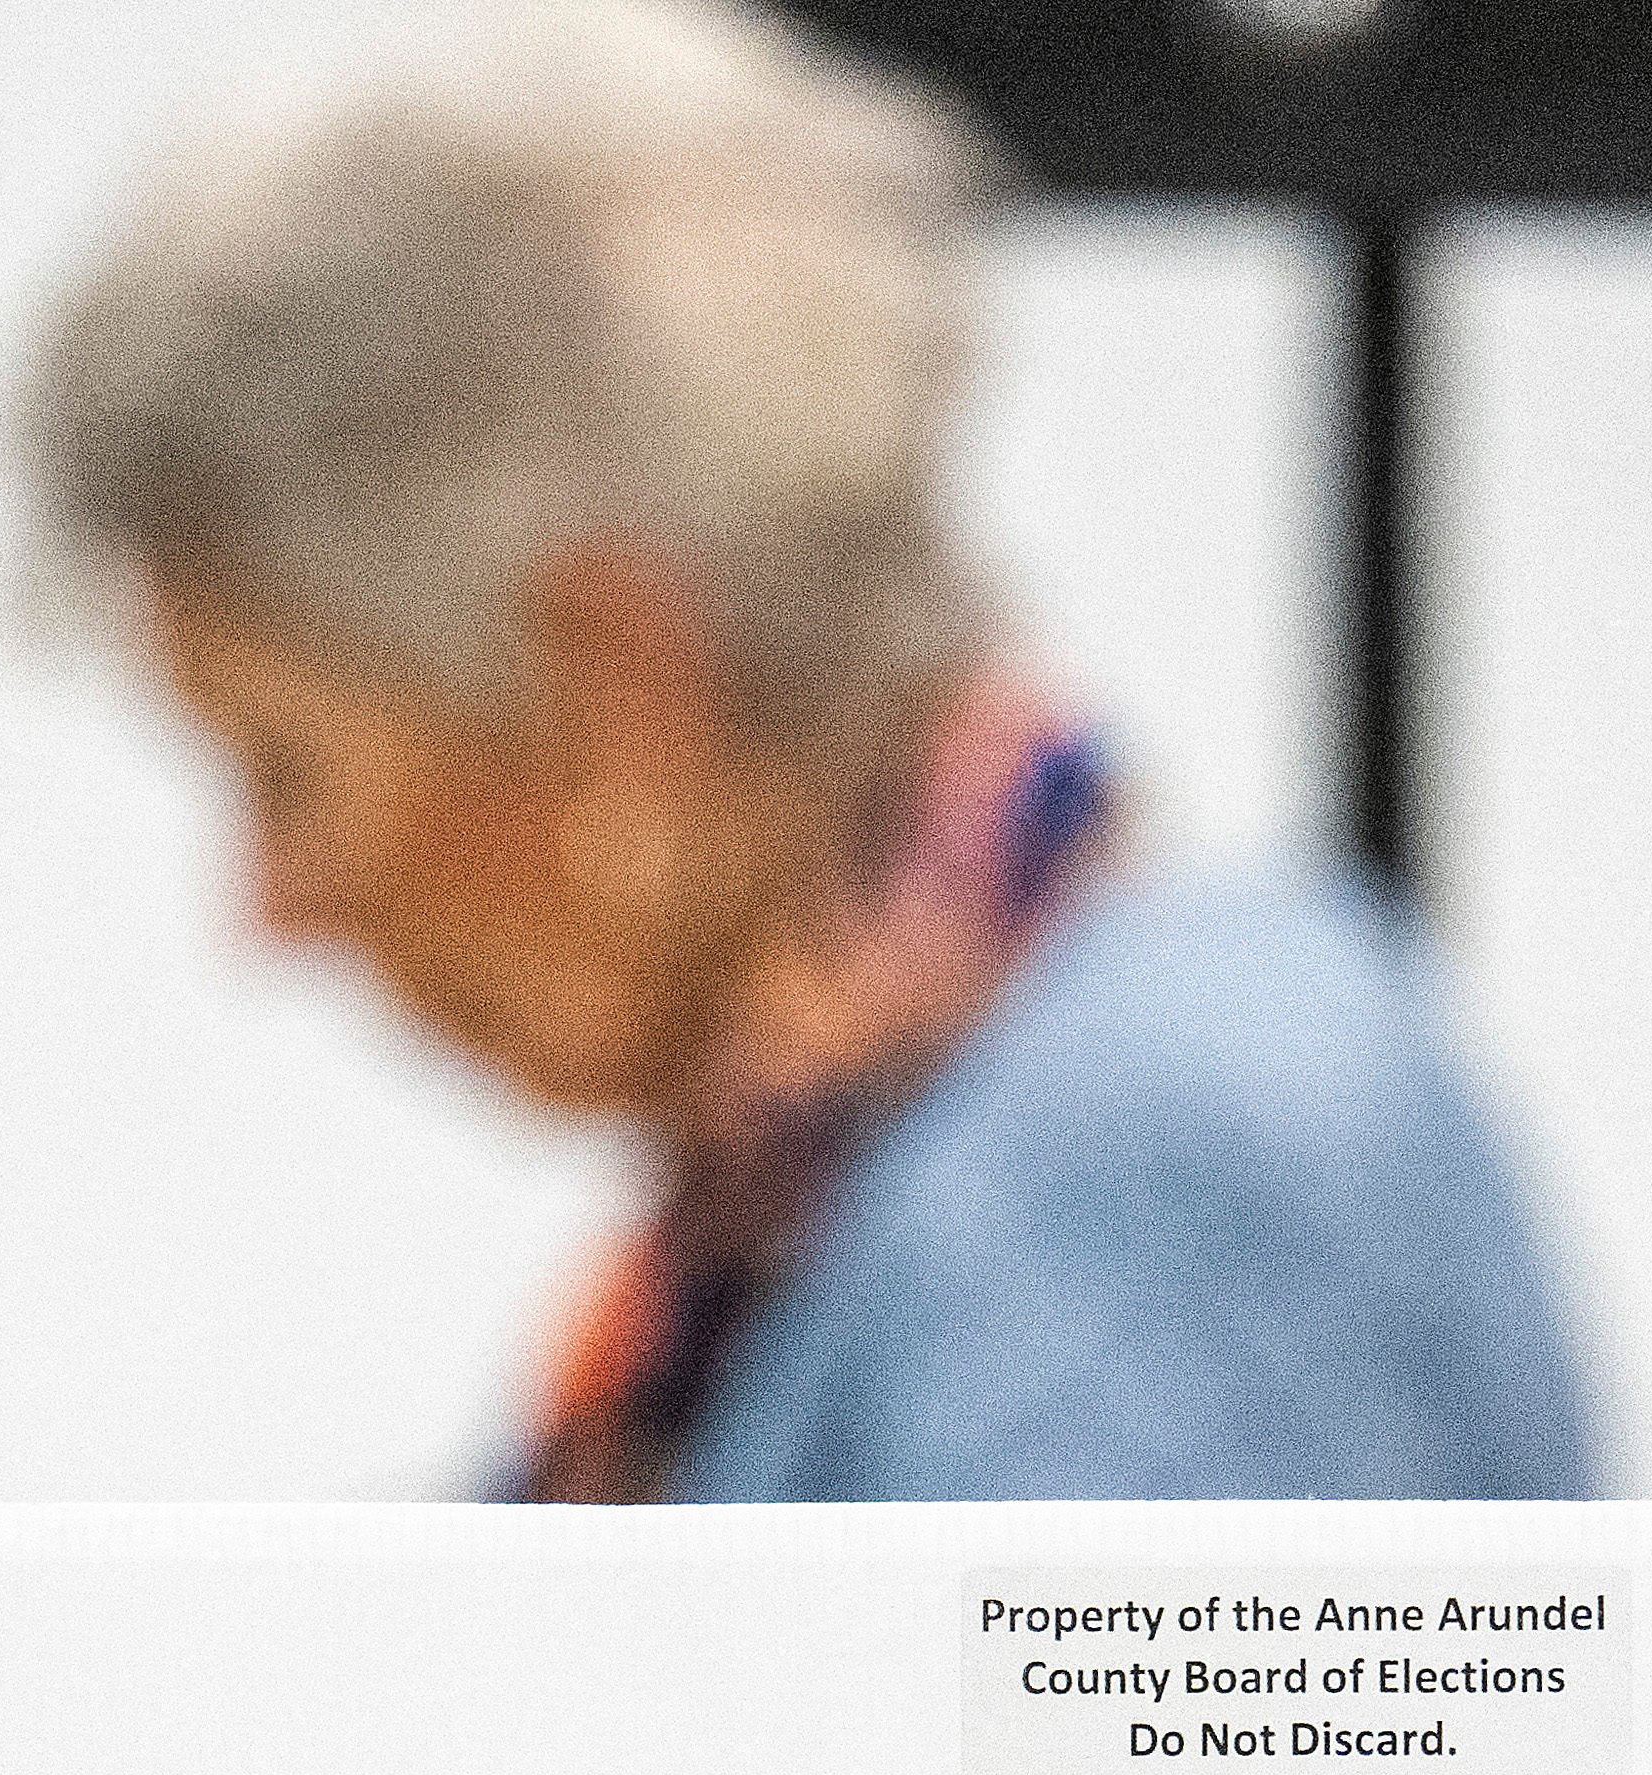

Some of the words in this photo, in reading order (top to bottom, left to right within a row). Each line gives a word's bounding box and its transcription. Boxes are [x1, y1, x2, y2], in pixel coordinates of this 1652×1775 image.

[982, 1598, 1165, 1642] Property
[1178, 1595, 1221, 1632] of
[1232, 1595, 1301, 1632] the
[1315, 1597, 1424, 1632] Anne
[1438, 1594, 1605, 1632] Arundel
[1022, 1660, 1171, 1704] County
[1185, 1657, 1307, 1694] Board
[1322, 1657, 1365, 1694] of
[1379, 1657, 1565, 1694] Elections
[1130, 1723, 1185, 1757] Do
[1201, 1722, 1276, 1757] Not
[1291, 1720, 1457, 1757] Discard.
